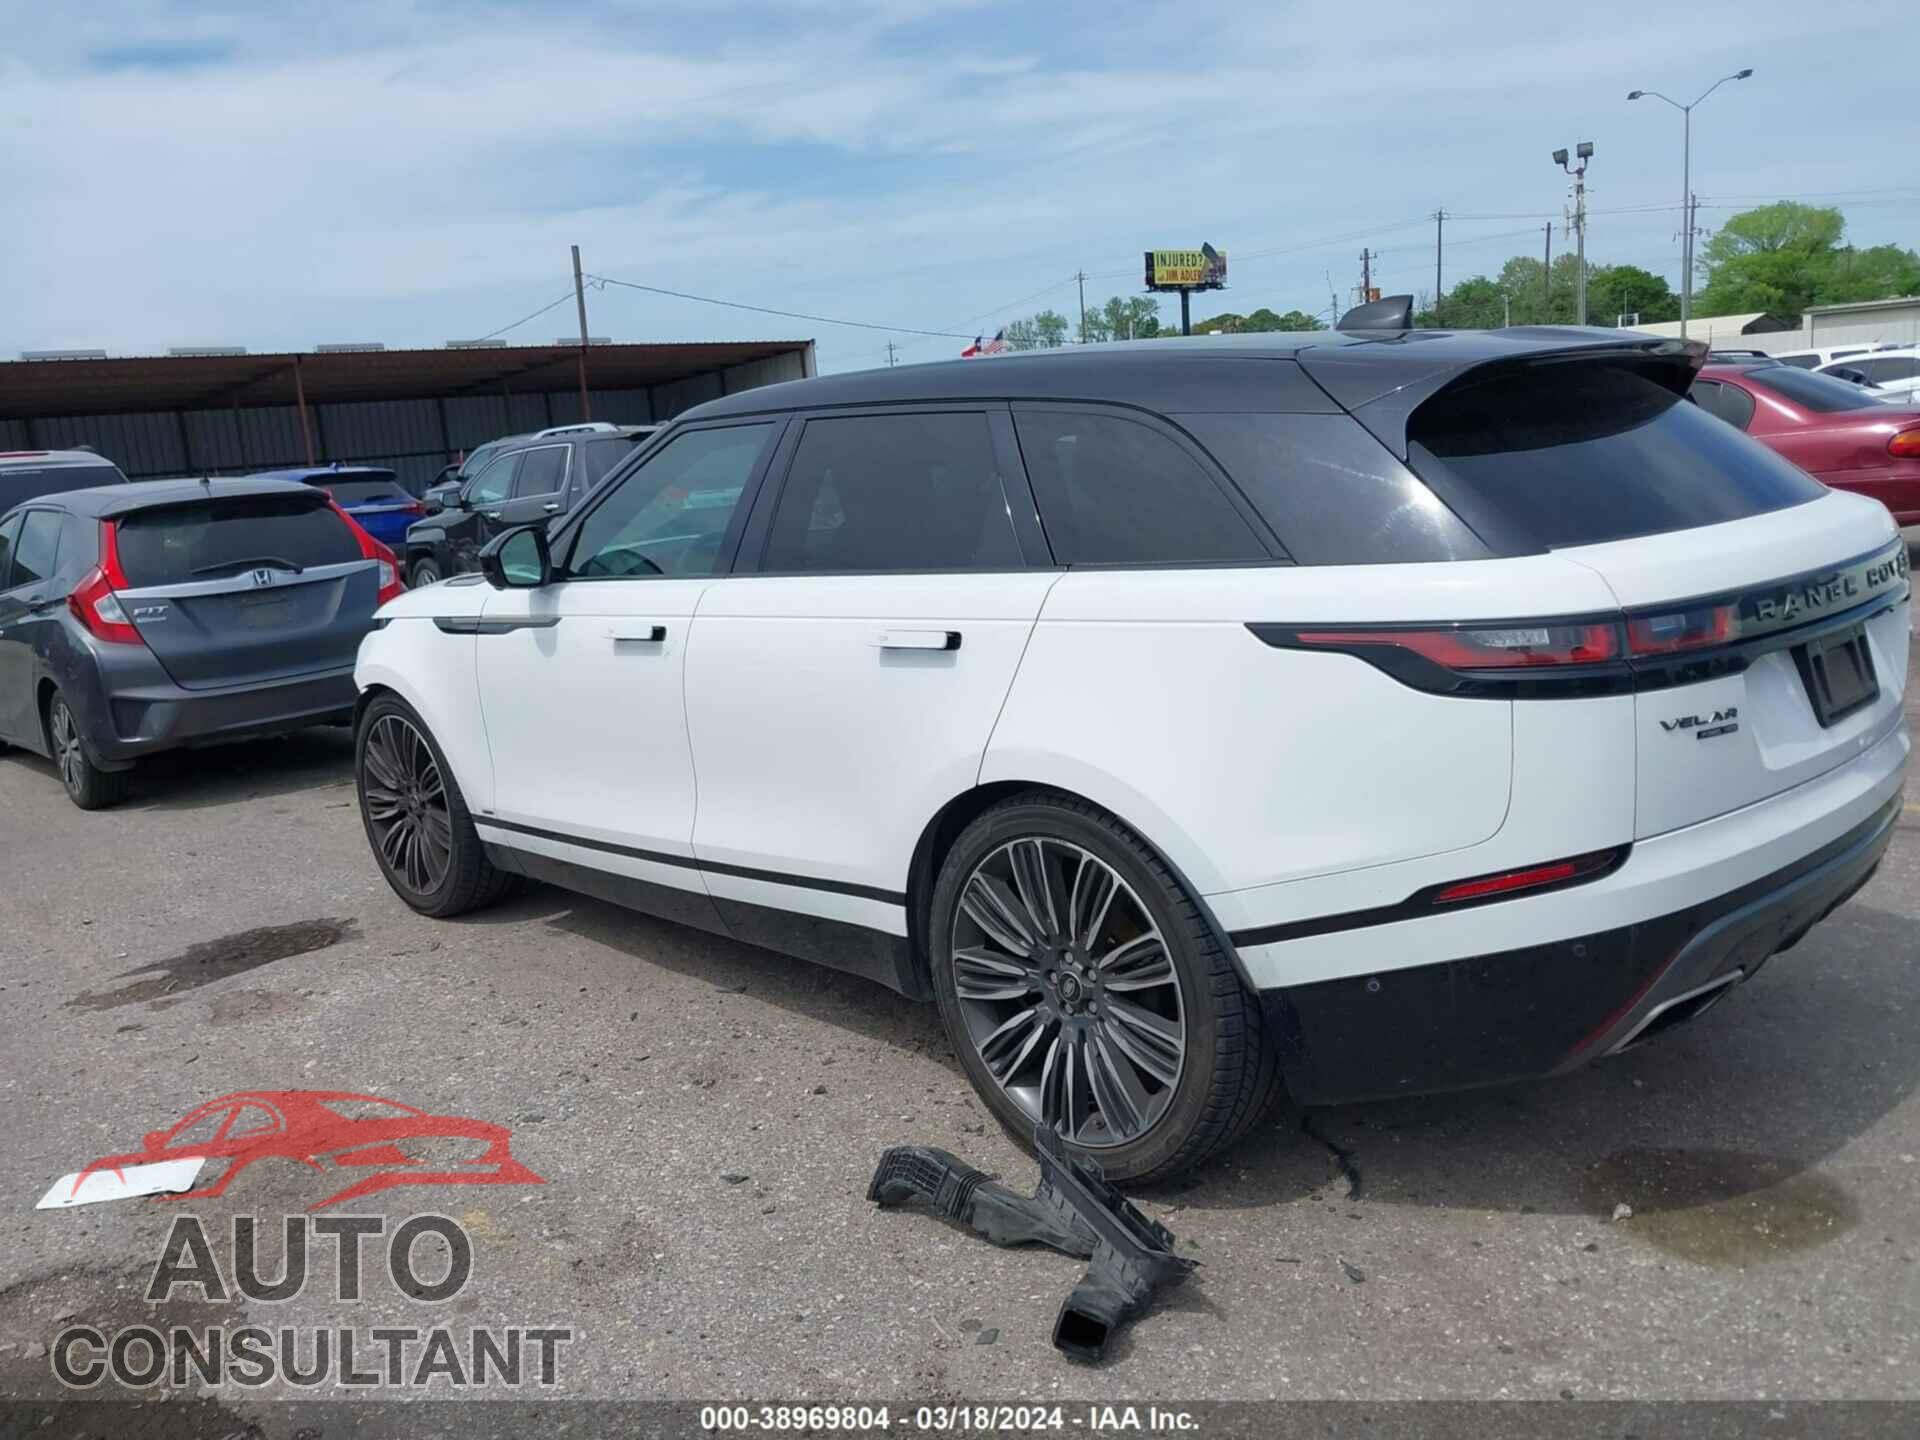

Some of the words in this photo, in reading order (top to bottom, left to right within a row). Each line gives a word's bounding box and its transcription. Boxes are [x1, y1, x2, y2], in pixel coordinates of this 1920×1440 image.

[1155, 253, 1203, 267] INJURED?
[133, 604, 168, 616] FIT
[1659, 707, 1738, 731] VELAR
